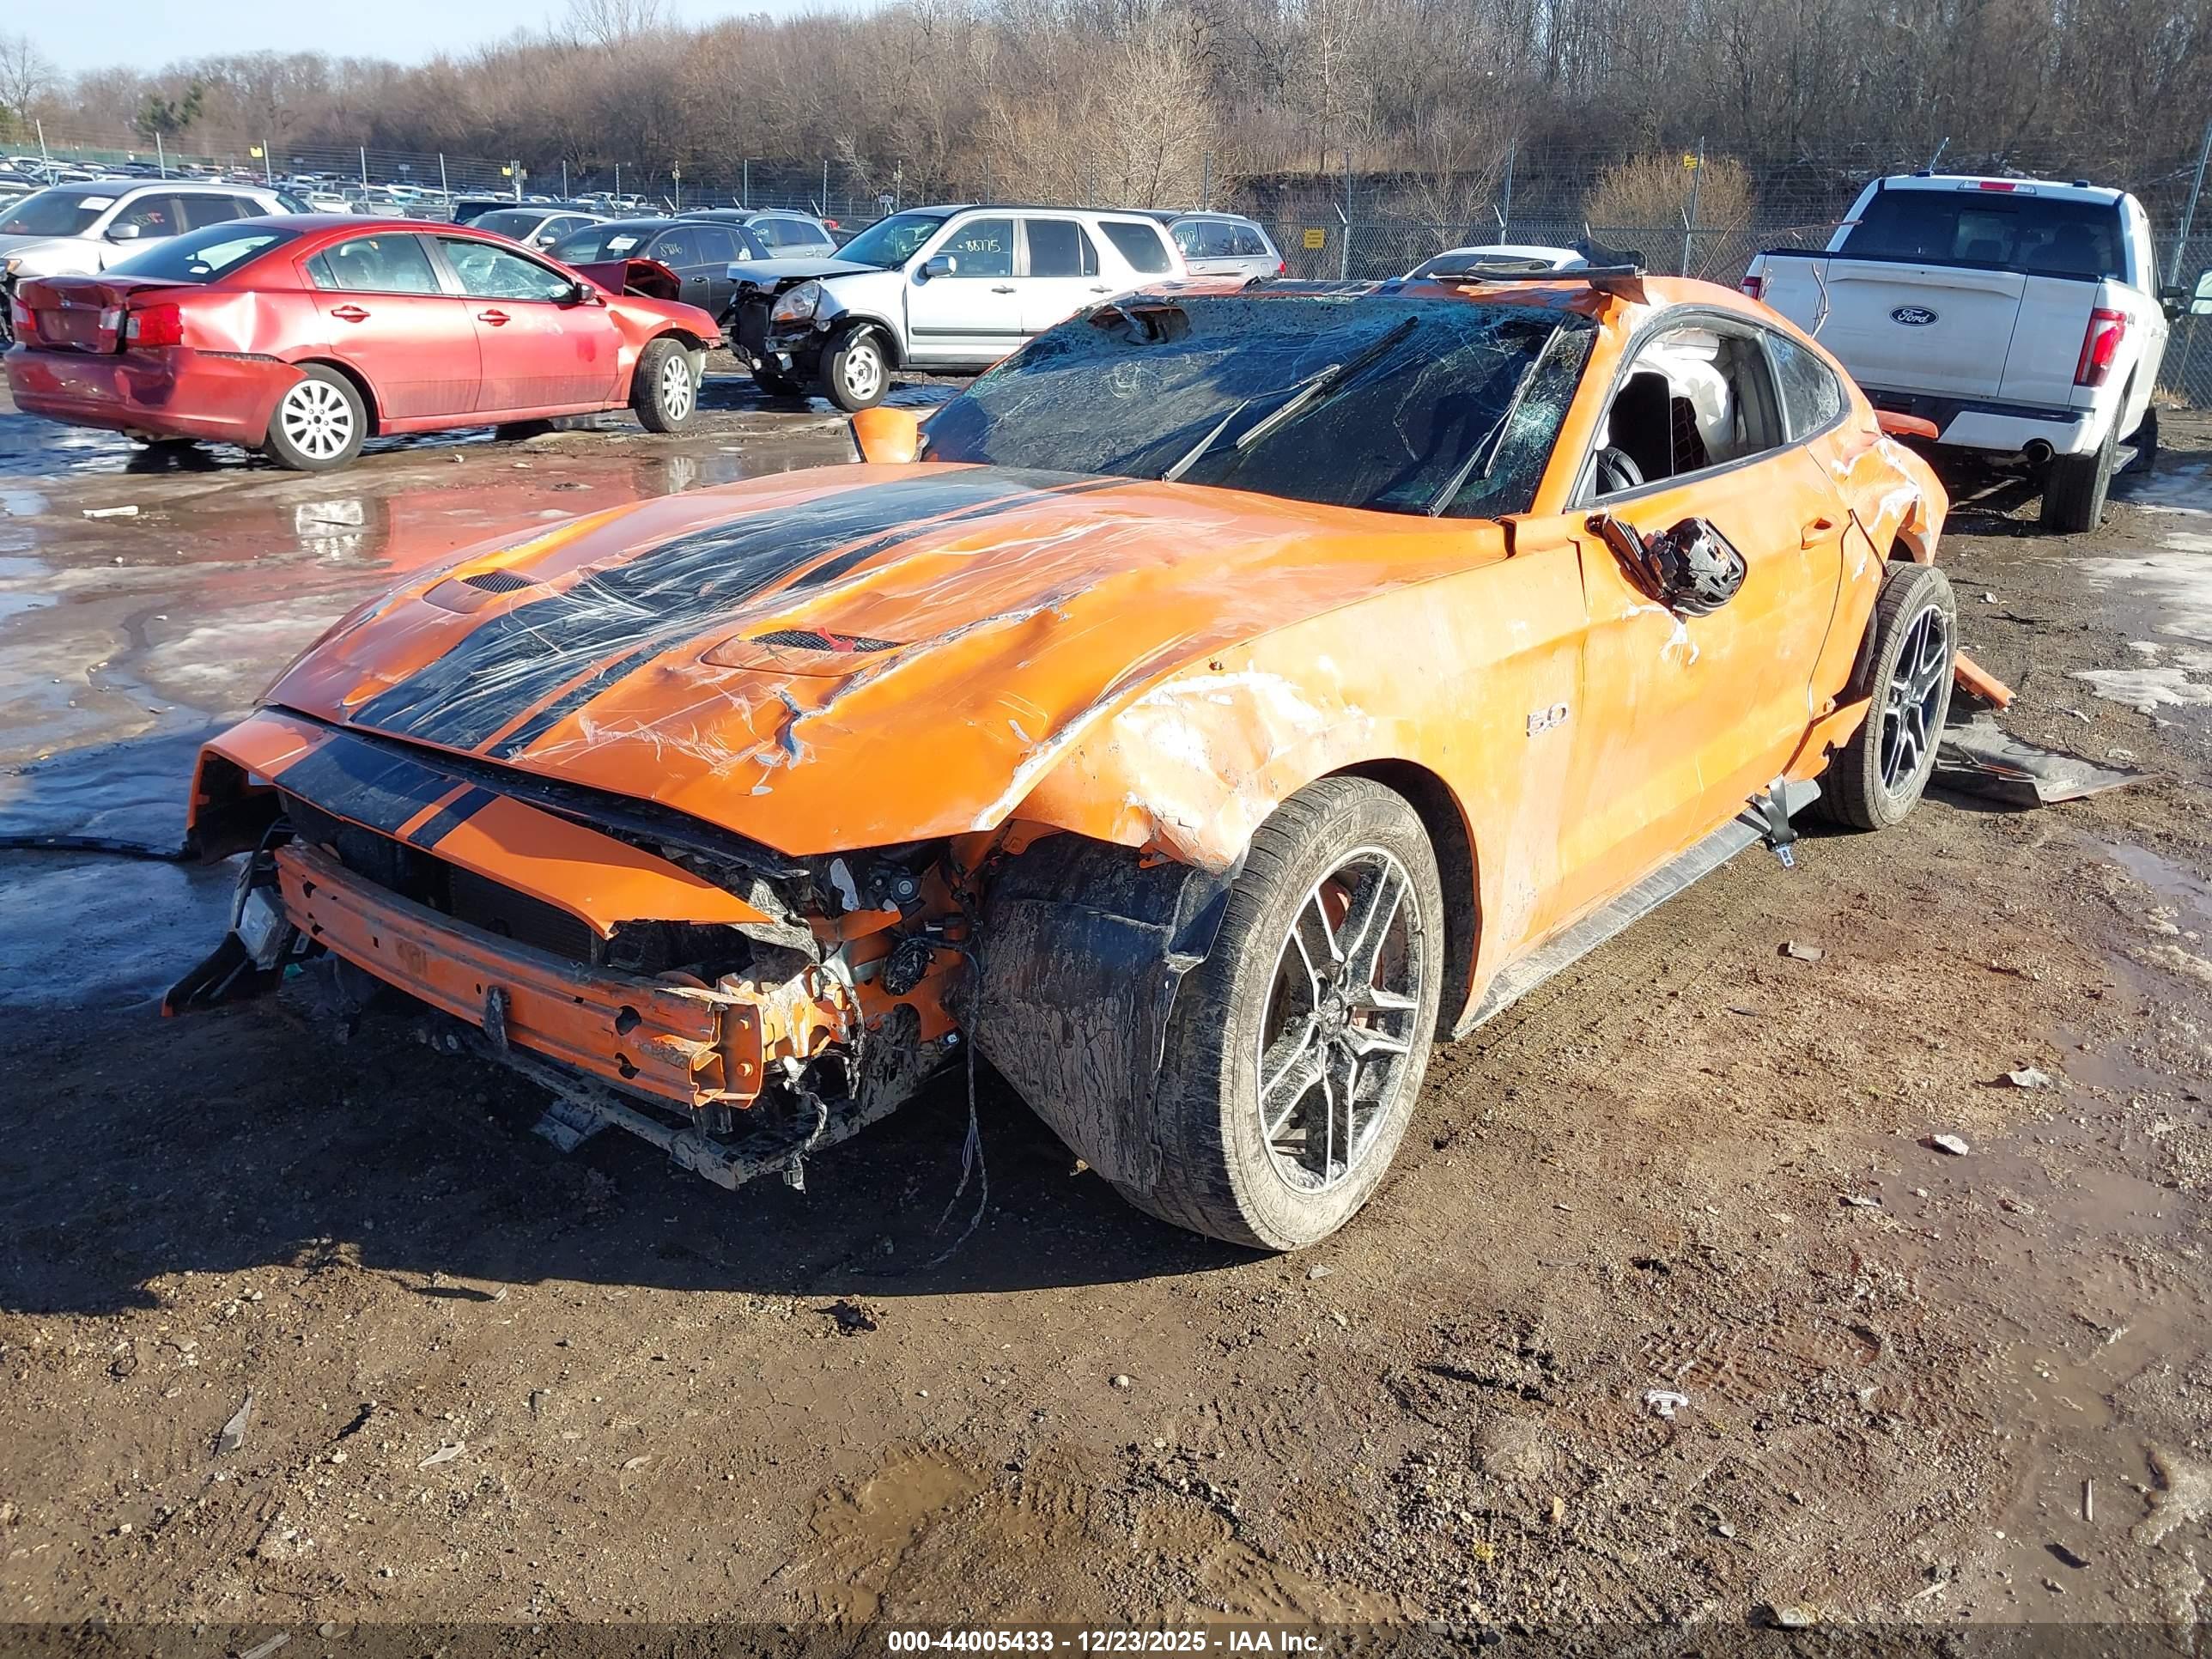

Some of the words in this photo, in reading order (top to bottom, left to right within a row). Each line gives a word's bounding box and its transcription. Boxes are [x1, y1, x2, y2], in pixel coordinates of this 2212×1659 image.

[965, 240, 1001, 253] 88775
[1898, 308, 1930, 324] Ford
[1526, 702, 1568, 737] 5.0
